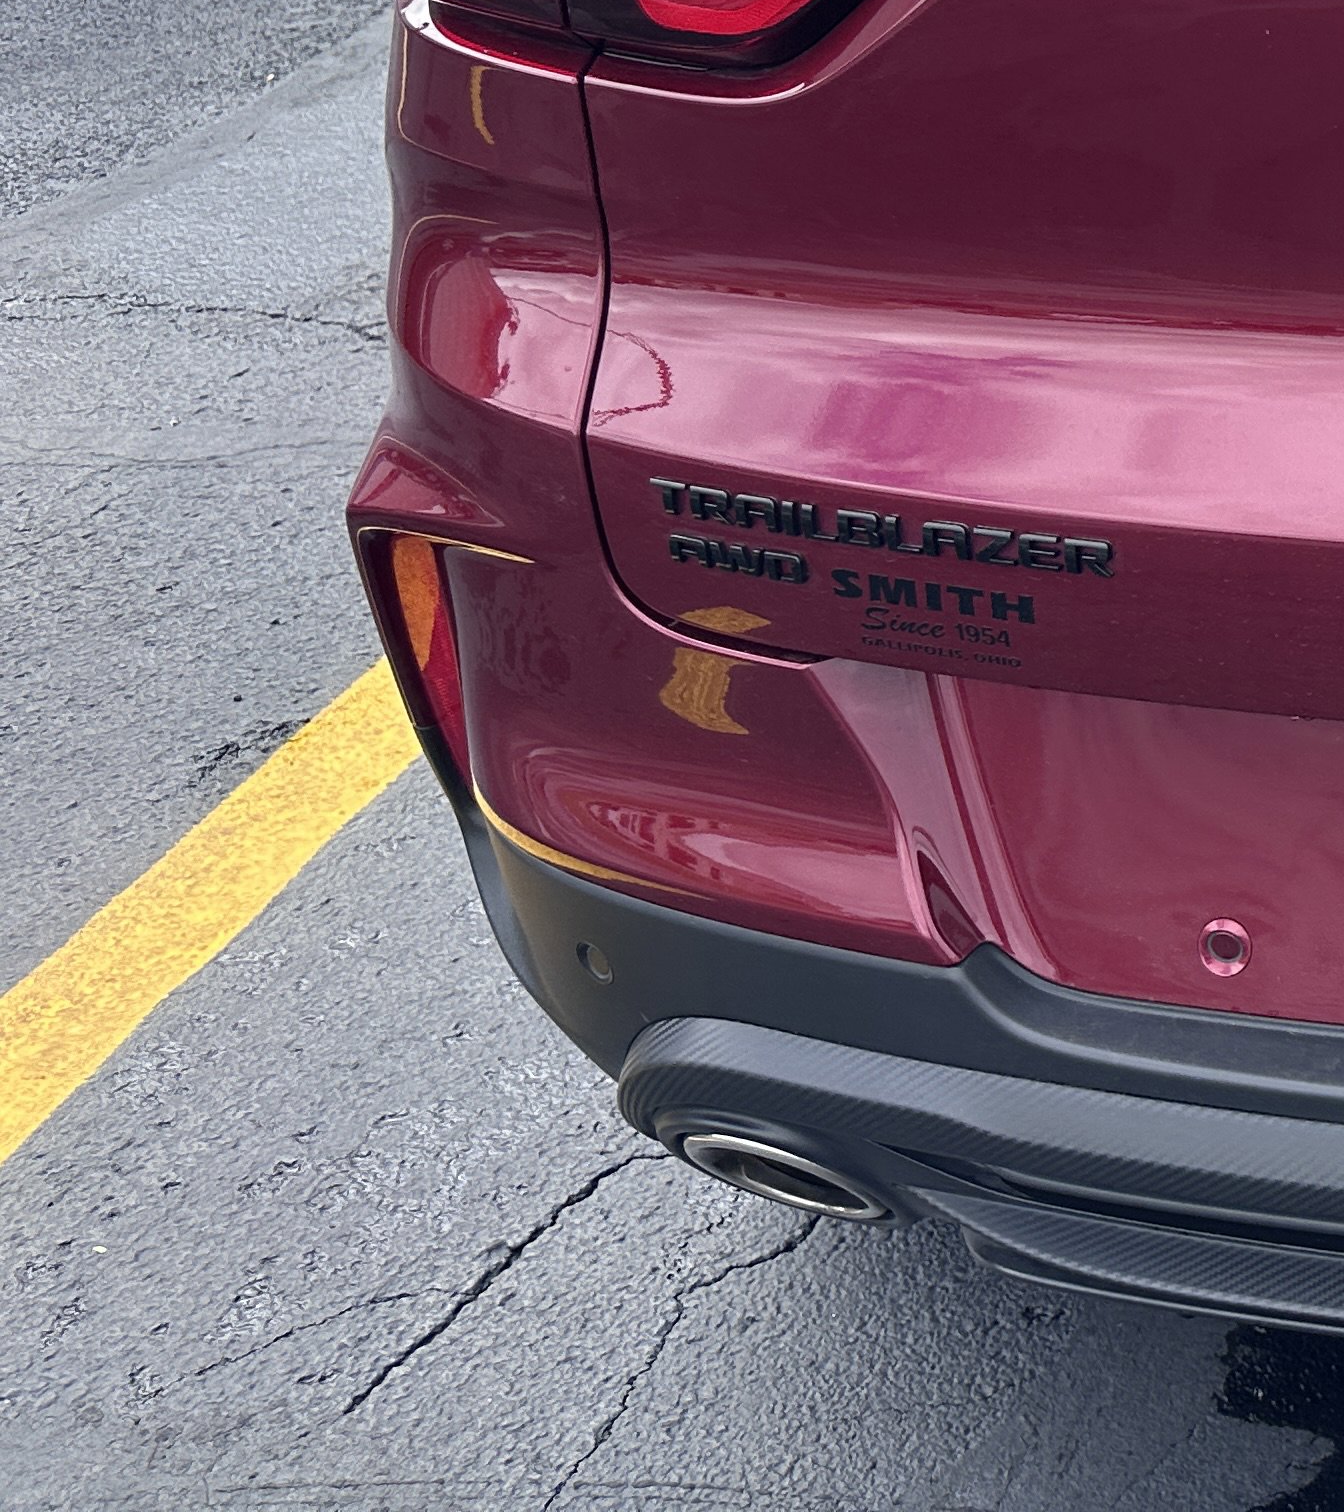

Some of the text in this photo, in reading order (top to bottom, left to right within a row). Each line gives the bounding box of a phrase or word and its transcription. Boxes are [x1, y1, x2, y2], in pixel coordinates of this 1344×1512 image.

[649, 475, 1117, 579] TRAILBLAZER
[667, 532, 811, 584] AWD
[830, 568, 1036, 625] SMITH
[861, 606, 1012, 648] Since 1954
[972, 652, 1023, 669] OHIO
